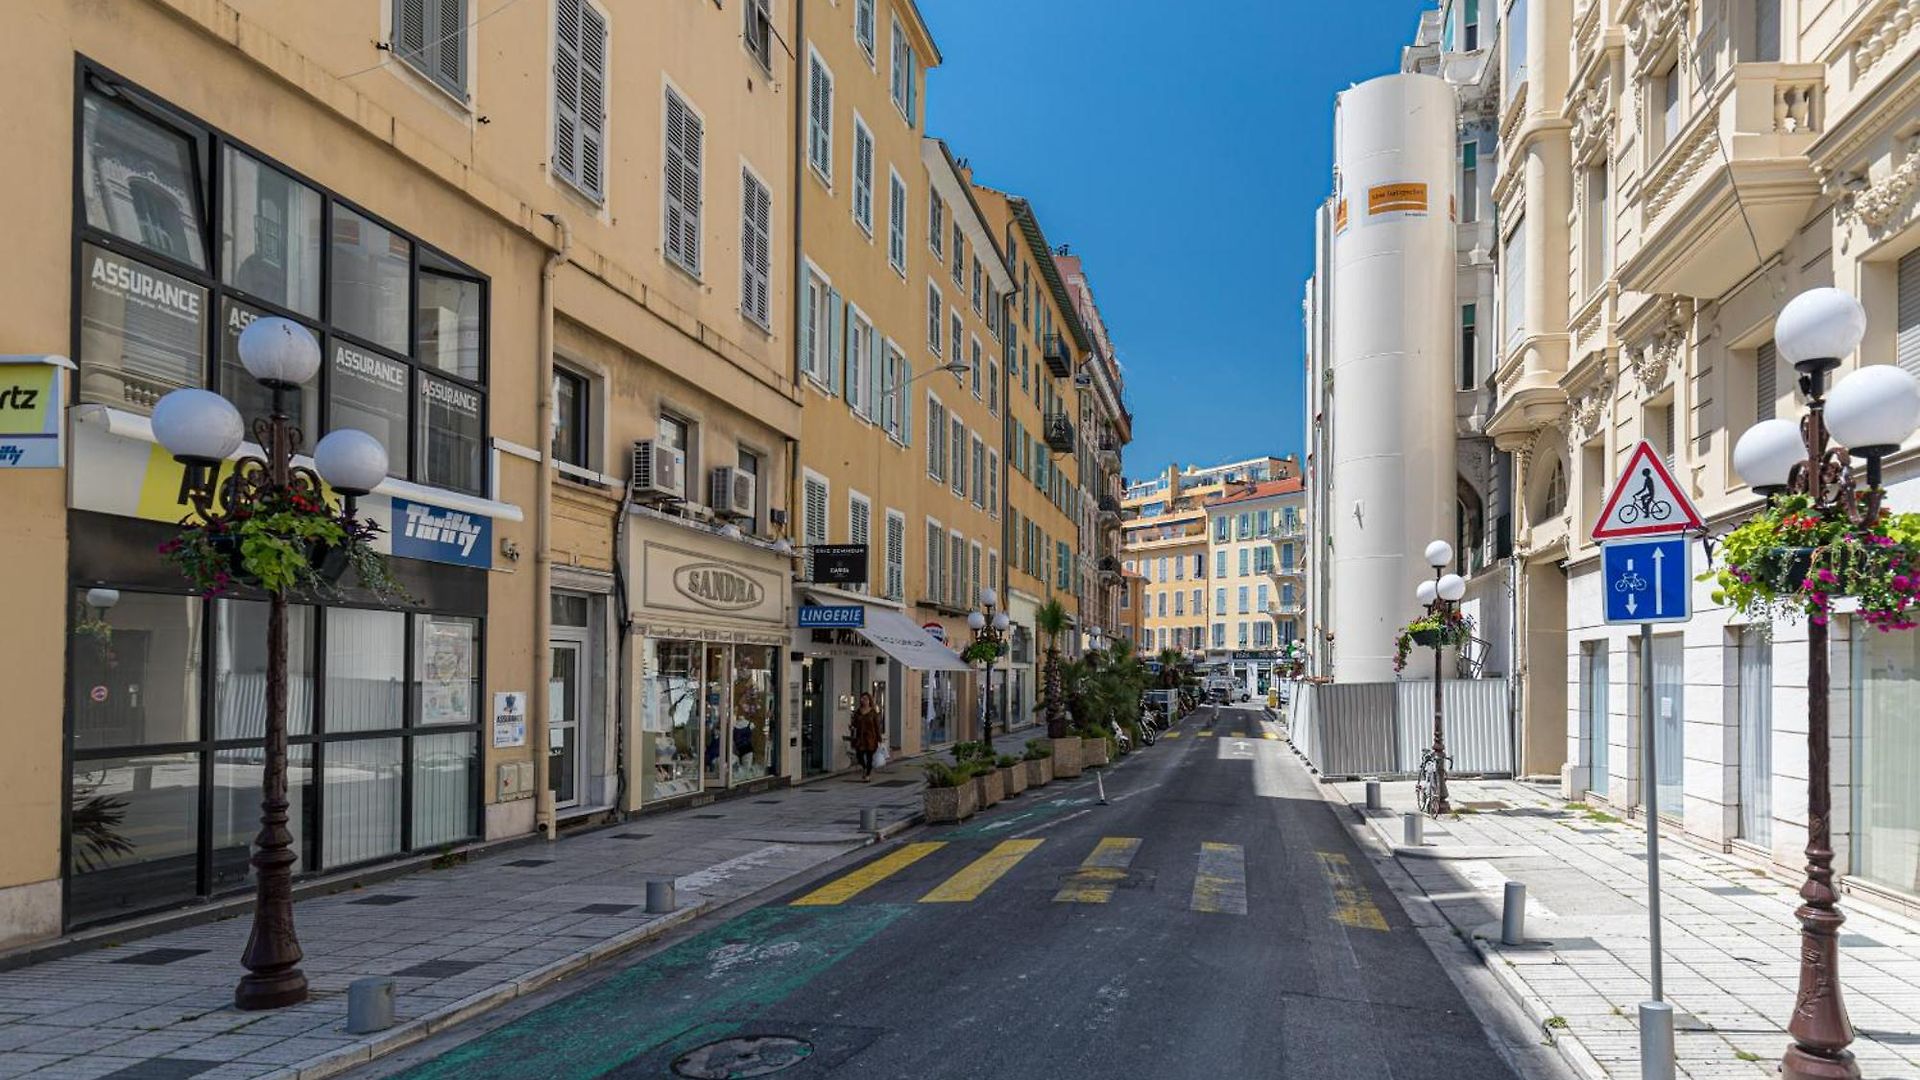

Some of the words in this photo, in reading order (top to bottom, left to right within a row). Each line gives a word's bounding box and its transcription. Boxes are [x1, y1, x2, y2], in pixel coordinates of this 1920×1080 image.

[91, 257, 200, 315] ASSURANCE
[336, 347, 404, 386] ASSURANCE
[422, 378, 478, 412] ASSURANCE
[405, 503, 482, 557] Thrifty
[688, 570, 757, 603] SANDRA
[801, 608, 861, 622] LINGERIE
